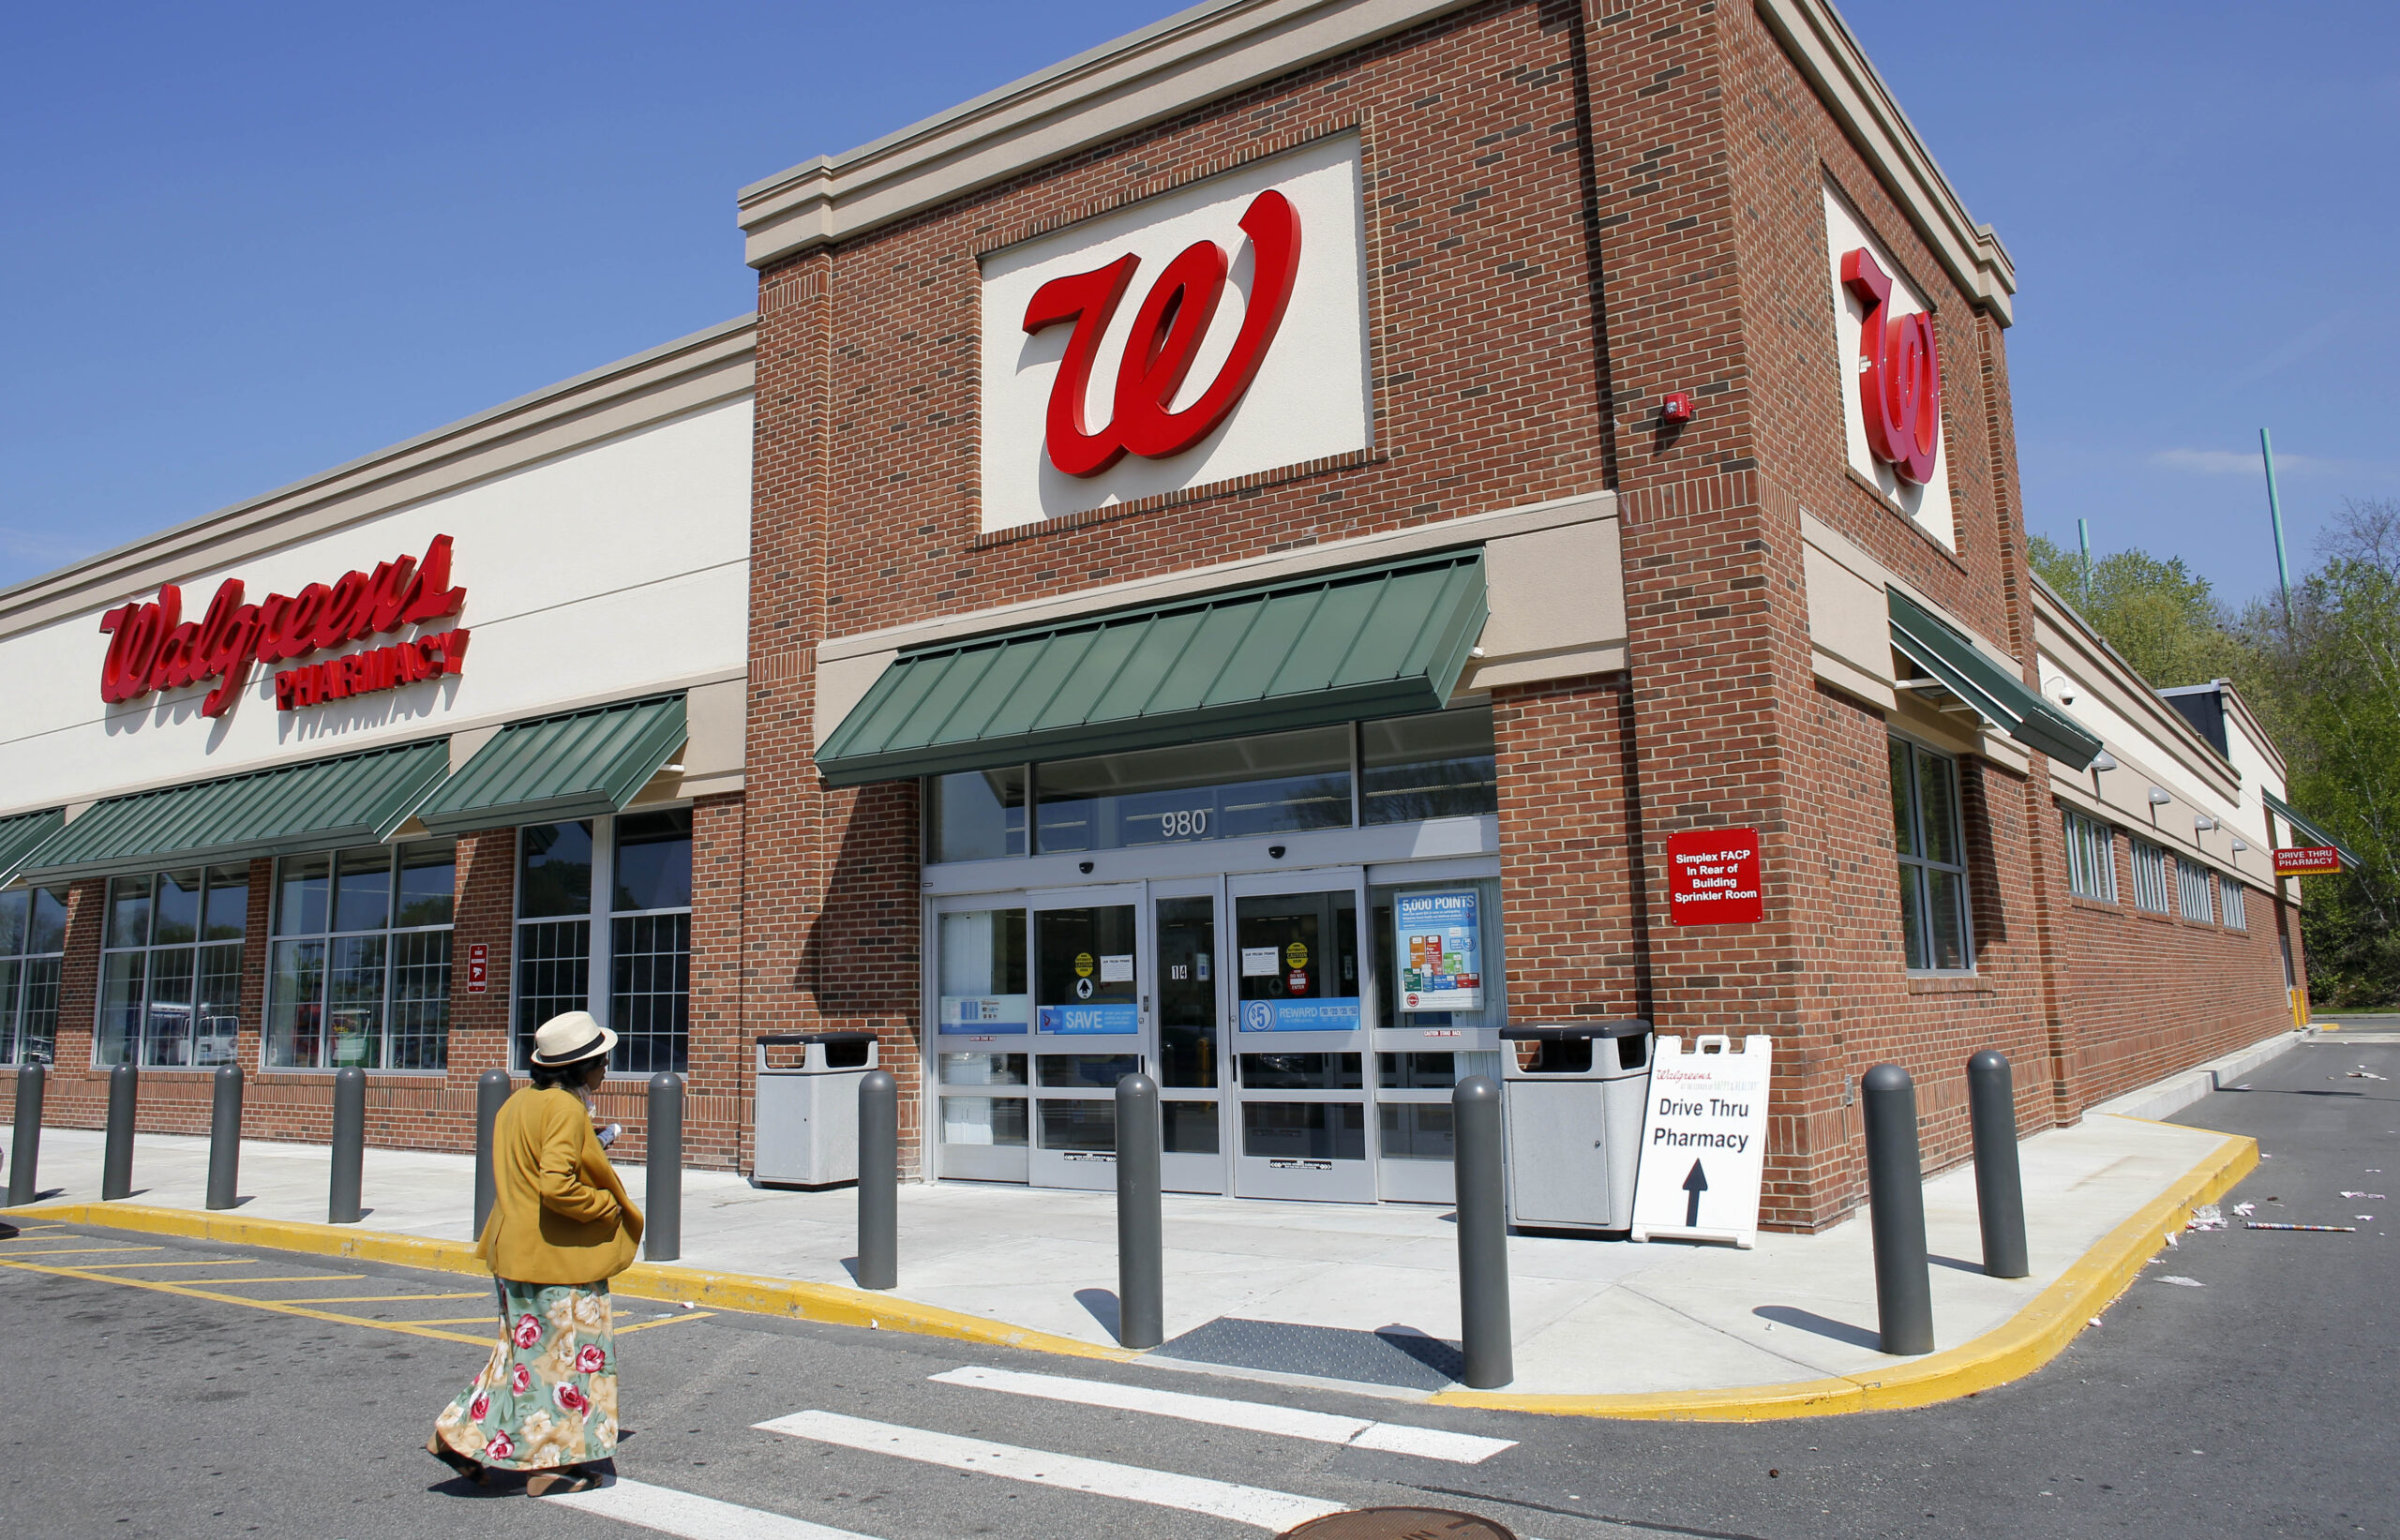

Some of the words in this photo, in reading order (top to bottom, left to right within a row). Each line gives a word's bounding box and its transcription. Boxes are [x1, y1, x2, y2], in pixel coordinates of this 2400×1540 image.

[1023, 189, 1301, 478] W
[99, 533, 467, 718] Walgreens
[276, 628, 471, 711] PHARMACY
[1162, 809, 1207, 837] 980
[1675, 853, 1718, 864] Simplex
[1720, 849, 1751, 860] FACP
[2279, 857, 2332, 866] PHARMACY
[1687, 867, 1697, 875] In
[1699, 865, 1724, 875] Rear
[1727, 863, 1739, 874] of
[1692, 877, 1737, 889] Building
[1402, 898, 1432, 913] 5,000
[1434, 895, 1475, 909] POINTS
[1674, 890, 1723, 904] Sprinkler
[1725, 890, 1758, 900] Room
[1172, 965, 1187, 979] 14
[1065, 1010, 1103, 1028] SAVE
[1251, 1006, 1266, 1027] $5
[1279, 1007, 1318, 1019] REWARD
[1656, 1069, 1713, 1084] Walgreens
[1659, 1098, 1703, 1116] Drive
[1709, 1099, 1749, 1117] Thru
[1653, 1128, 1749, 1153] Pharmacy
